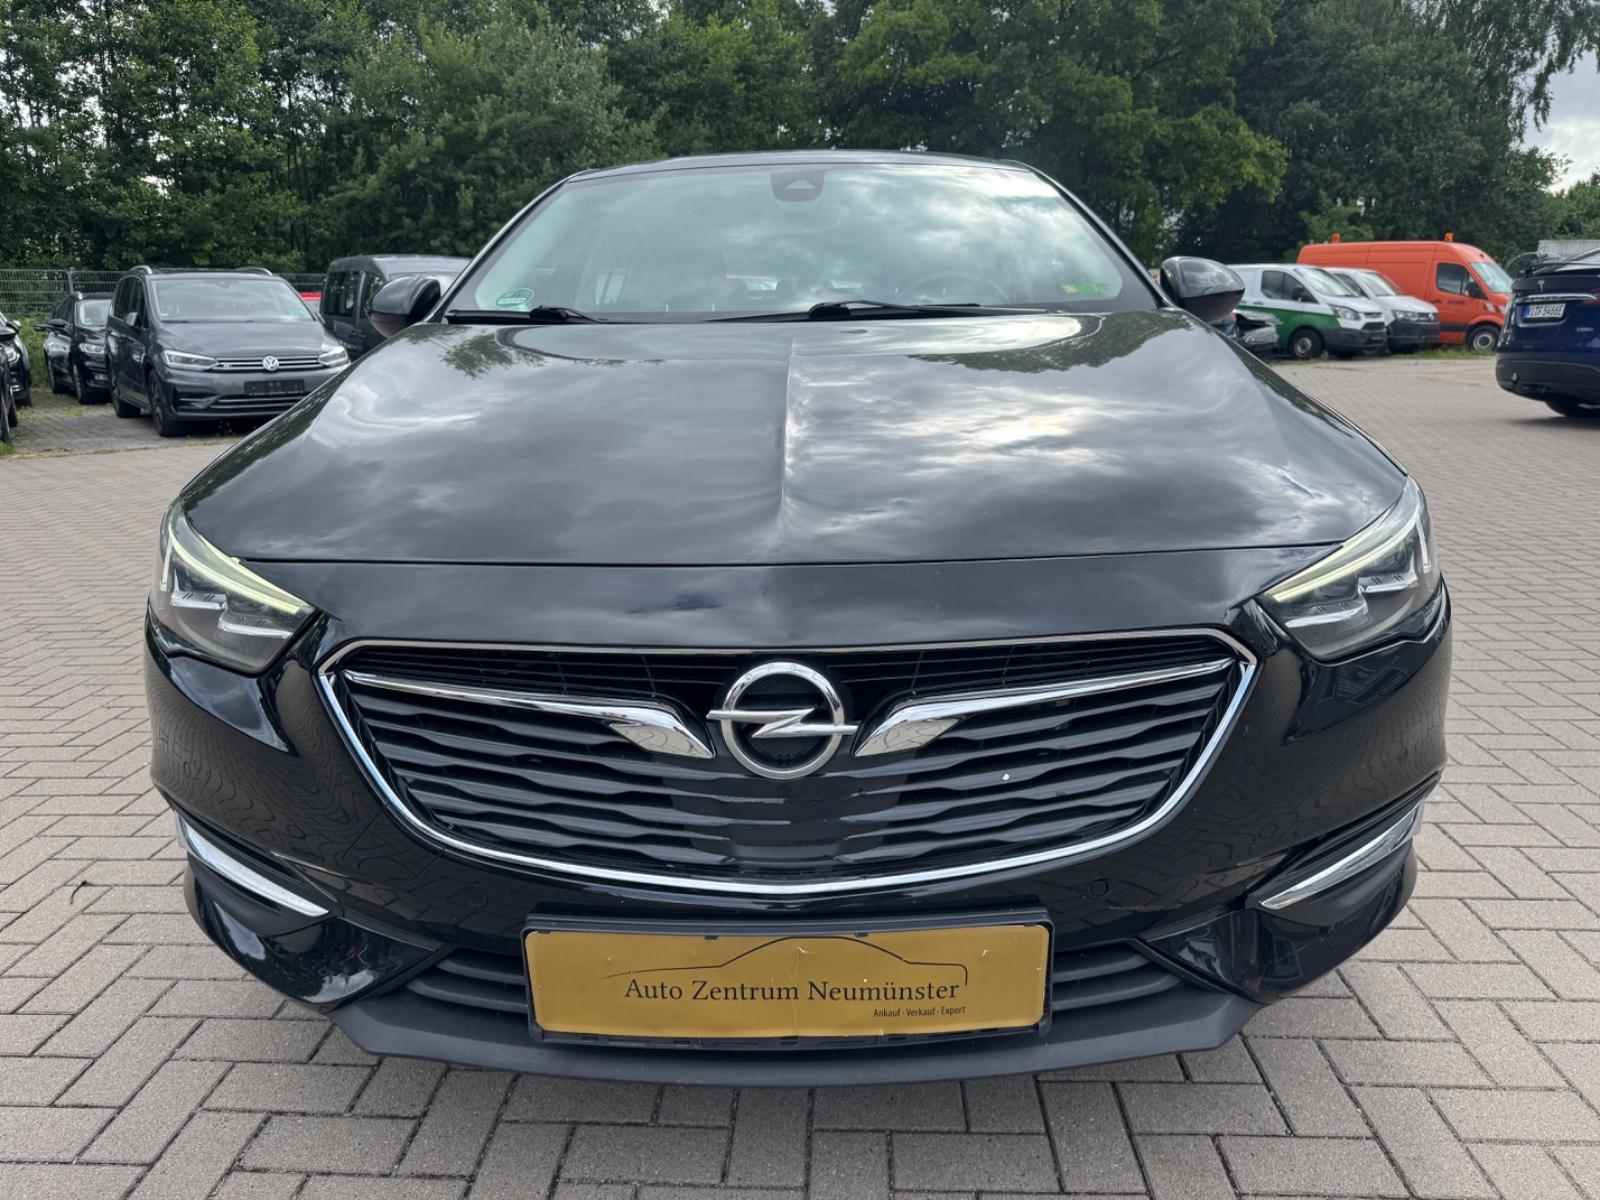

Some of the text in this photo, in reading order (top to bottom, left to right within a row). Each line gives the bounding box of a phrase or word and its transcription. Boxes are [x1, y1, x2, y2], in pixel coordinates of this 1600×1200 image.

[624, 978, 960, 1002] Auto Zentrum Neumünster
[873, 1005, 966, 1018] Ankauf Verkauf Export
